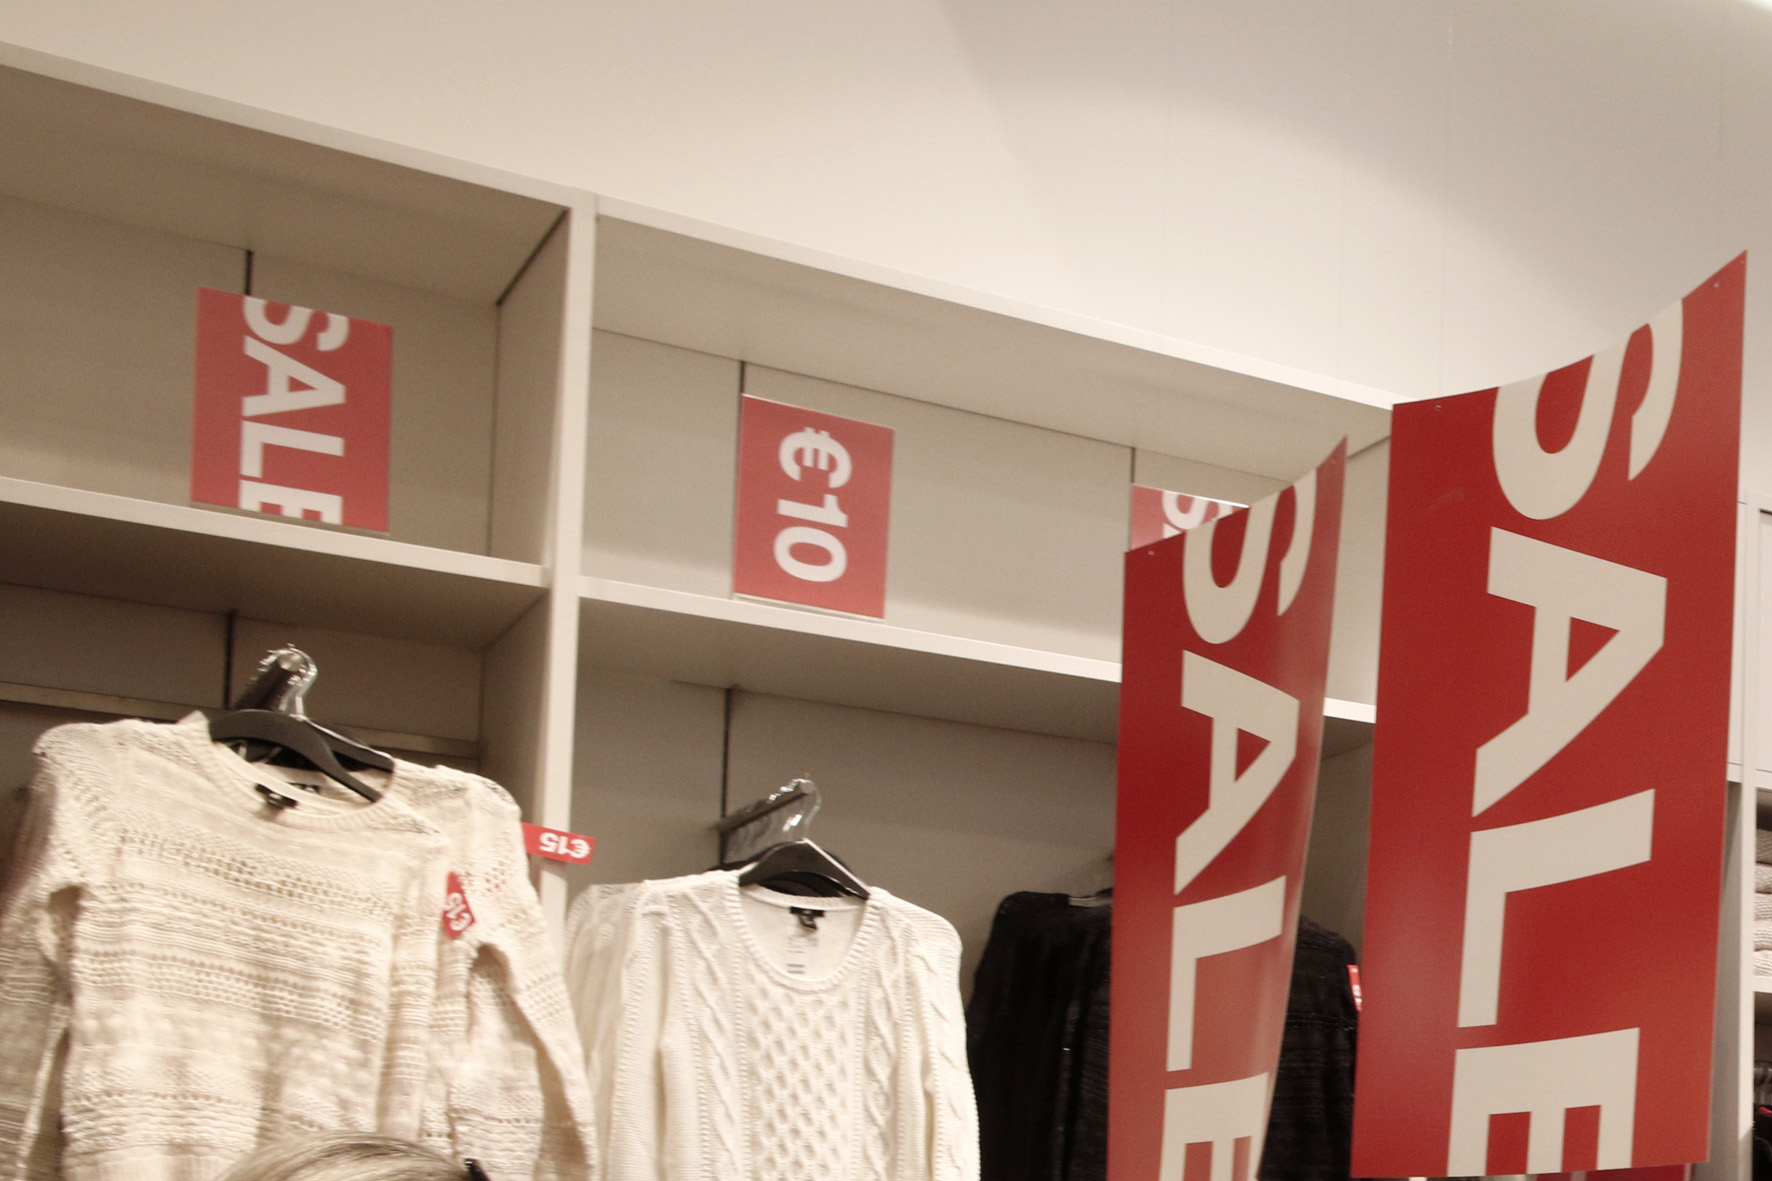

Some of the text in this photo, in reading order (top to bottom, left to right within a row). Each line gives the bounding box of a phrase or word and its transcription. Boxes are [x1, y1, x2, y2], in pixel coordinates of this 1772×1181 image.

[238, 296, 350, 524] SALE
[774, 428, 852, 584] €10
[1447, 299, 1683, 1177] SALE
[539, 832, 591, 859] €15
